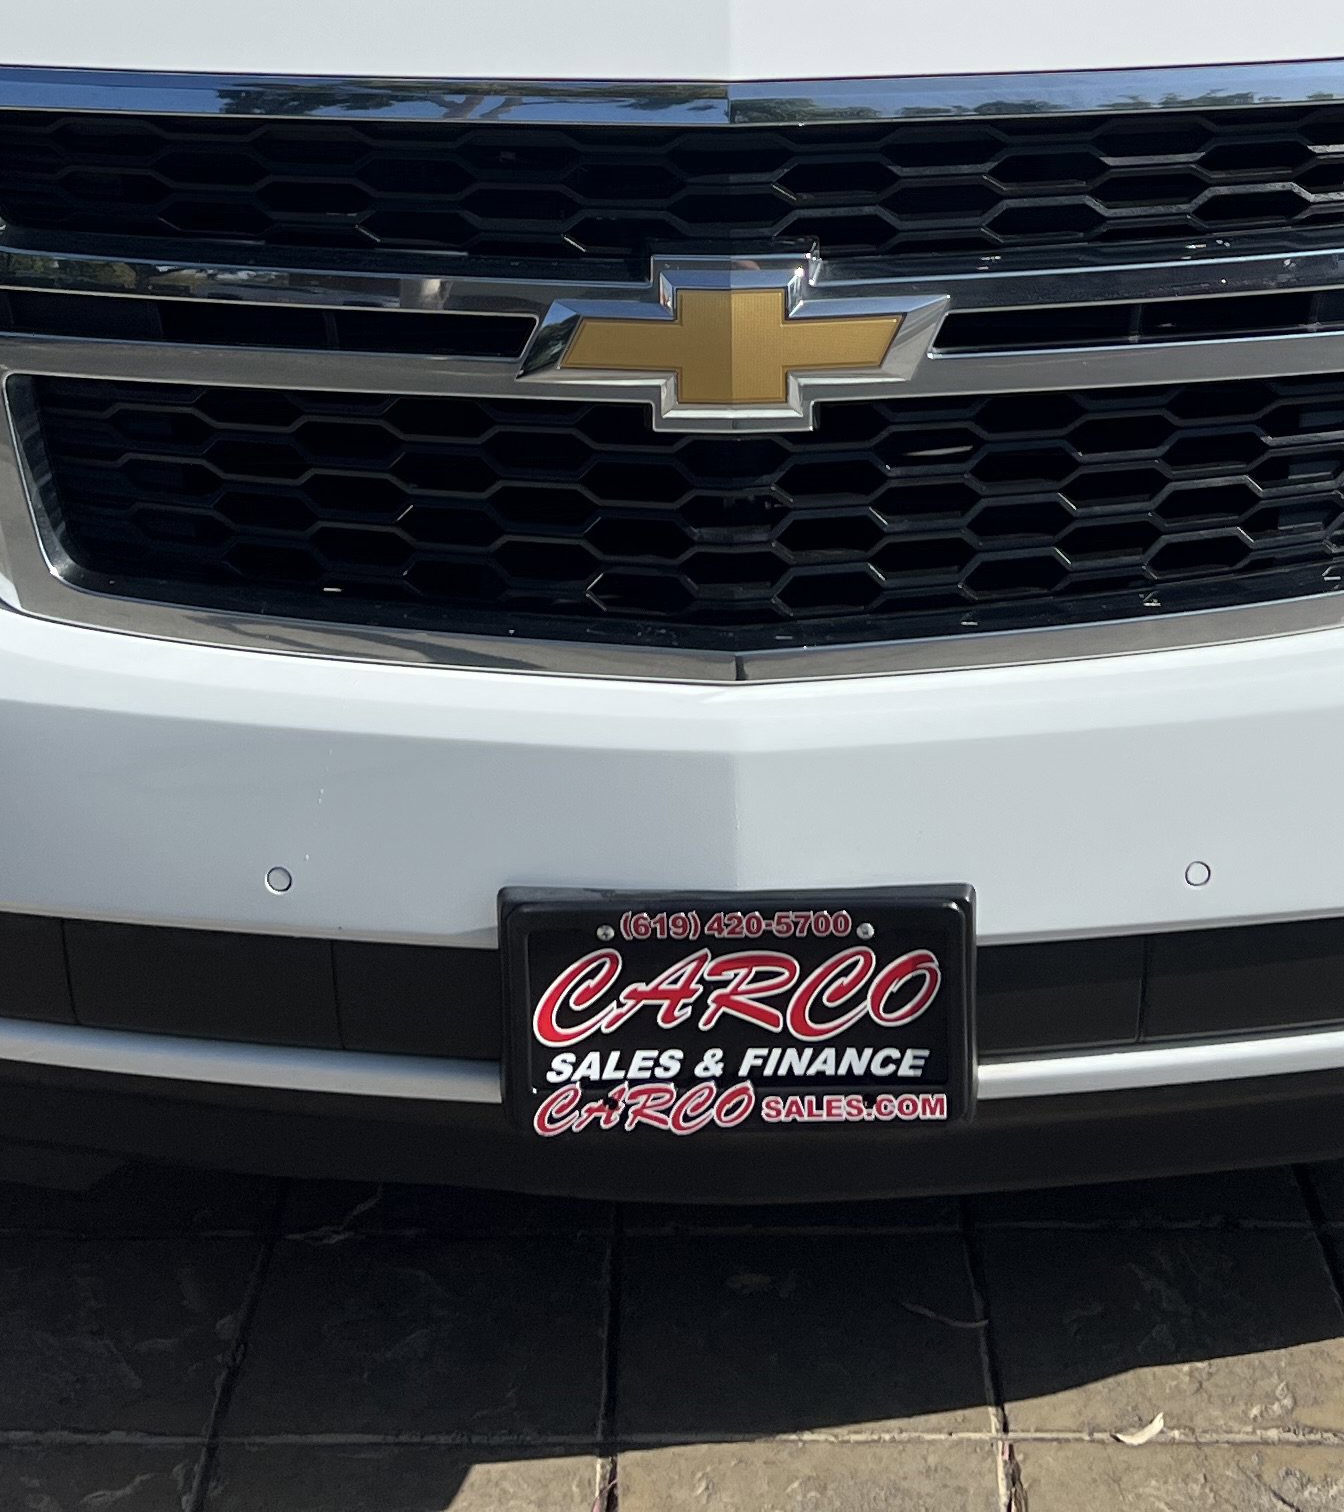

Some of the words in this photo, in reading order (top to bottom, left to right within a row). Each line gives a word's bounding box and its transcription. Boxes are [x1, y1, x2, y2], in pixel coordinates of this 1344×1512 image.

[619, 911, 701, 941] (619)
[706, 910, 853, 939] 420-5700
[532, 945, 942, 1049] CARCO
[545, 1048, 685, 1083] SALES
[693, 1048, 725, 1080] &
[737, 1047, 931, 1079] FINANCE
[533, 1082, 756, 1138] CARCO
[760, 1093, 949, 1124] SALES.COM
